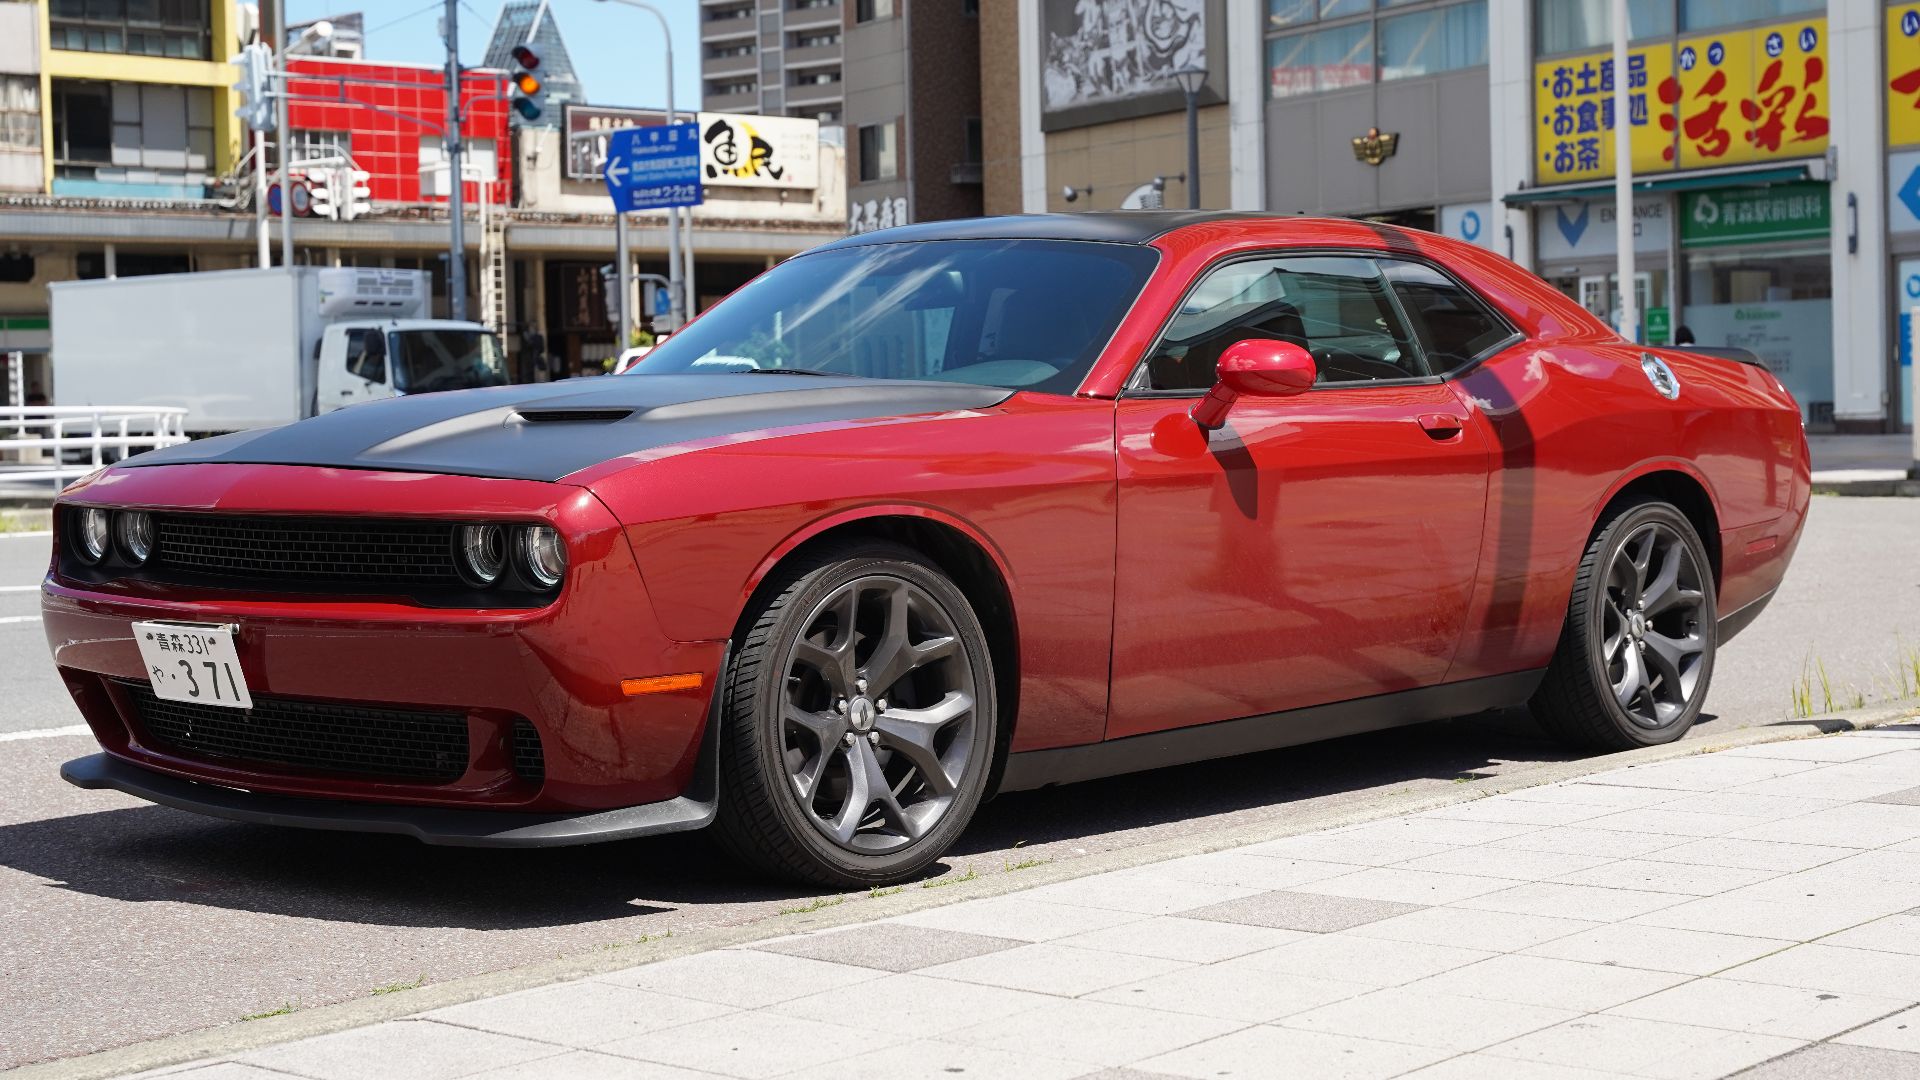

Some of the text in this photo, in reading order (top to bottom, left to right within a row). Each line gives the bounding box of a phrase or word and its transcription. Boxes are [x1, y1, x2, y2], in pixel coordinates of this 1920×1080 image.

[1658, 57, 1829, 162] 活彩
[705, 119, 783, 180] 魚民
[1600, 203, 1662, 222] ENANCE
